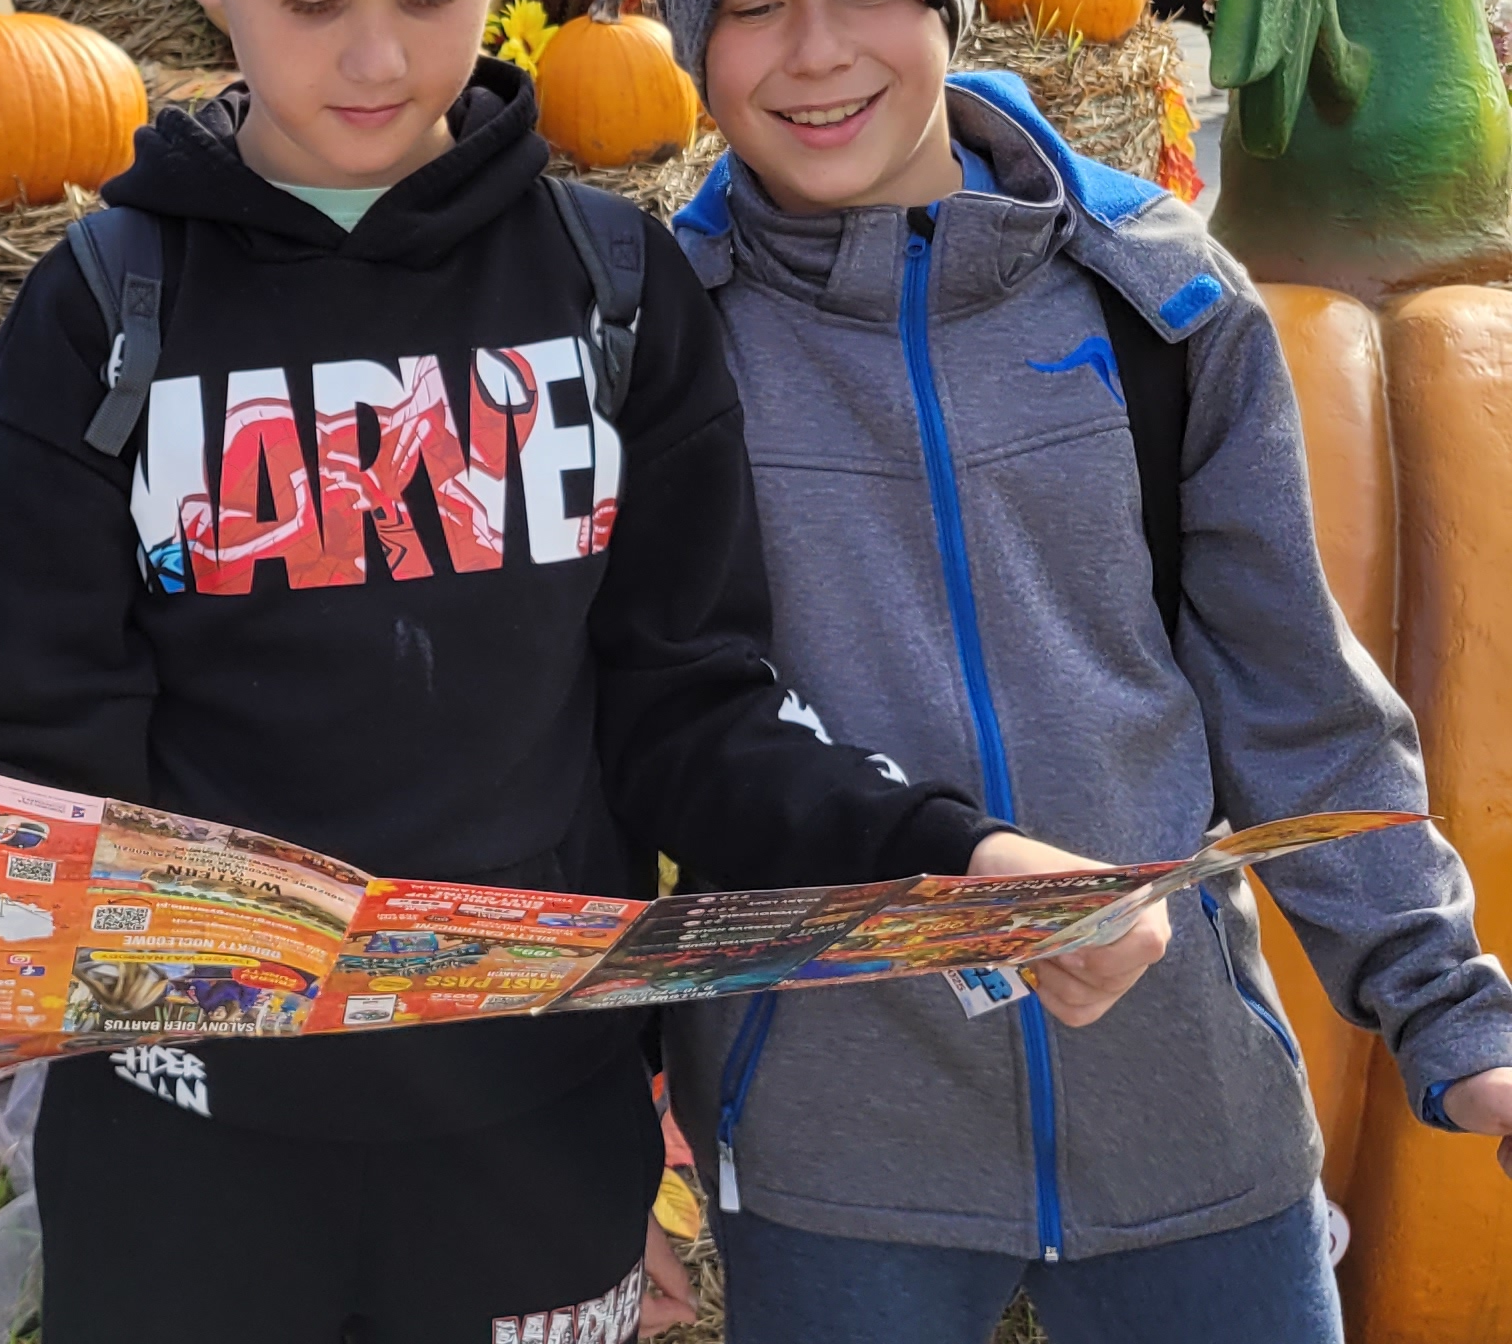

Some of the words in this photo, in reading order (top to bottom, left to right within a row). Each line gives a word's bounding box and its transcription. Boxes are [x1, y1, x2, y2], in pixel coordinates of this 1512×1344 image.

[165, 865, 283, 897] WESTERN
[122, 935, 215, 948] NOCLEGOWE
[423, 975, 491, 989] PASS
[497, 978, 561, 990] FAST
[948, 968, 966, 993] 025
[104, 1019, 161, 1032] BARTUŚ
[164, 1020, 196, 1031] GIER
[199, 1021, 256, 1032] SALONY
